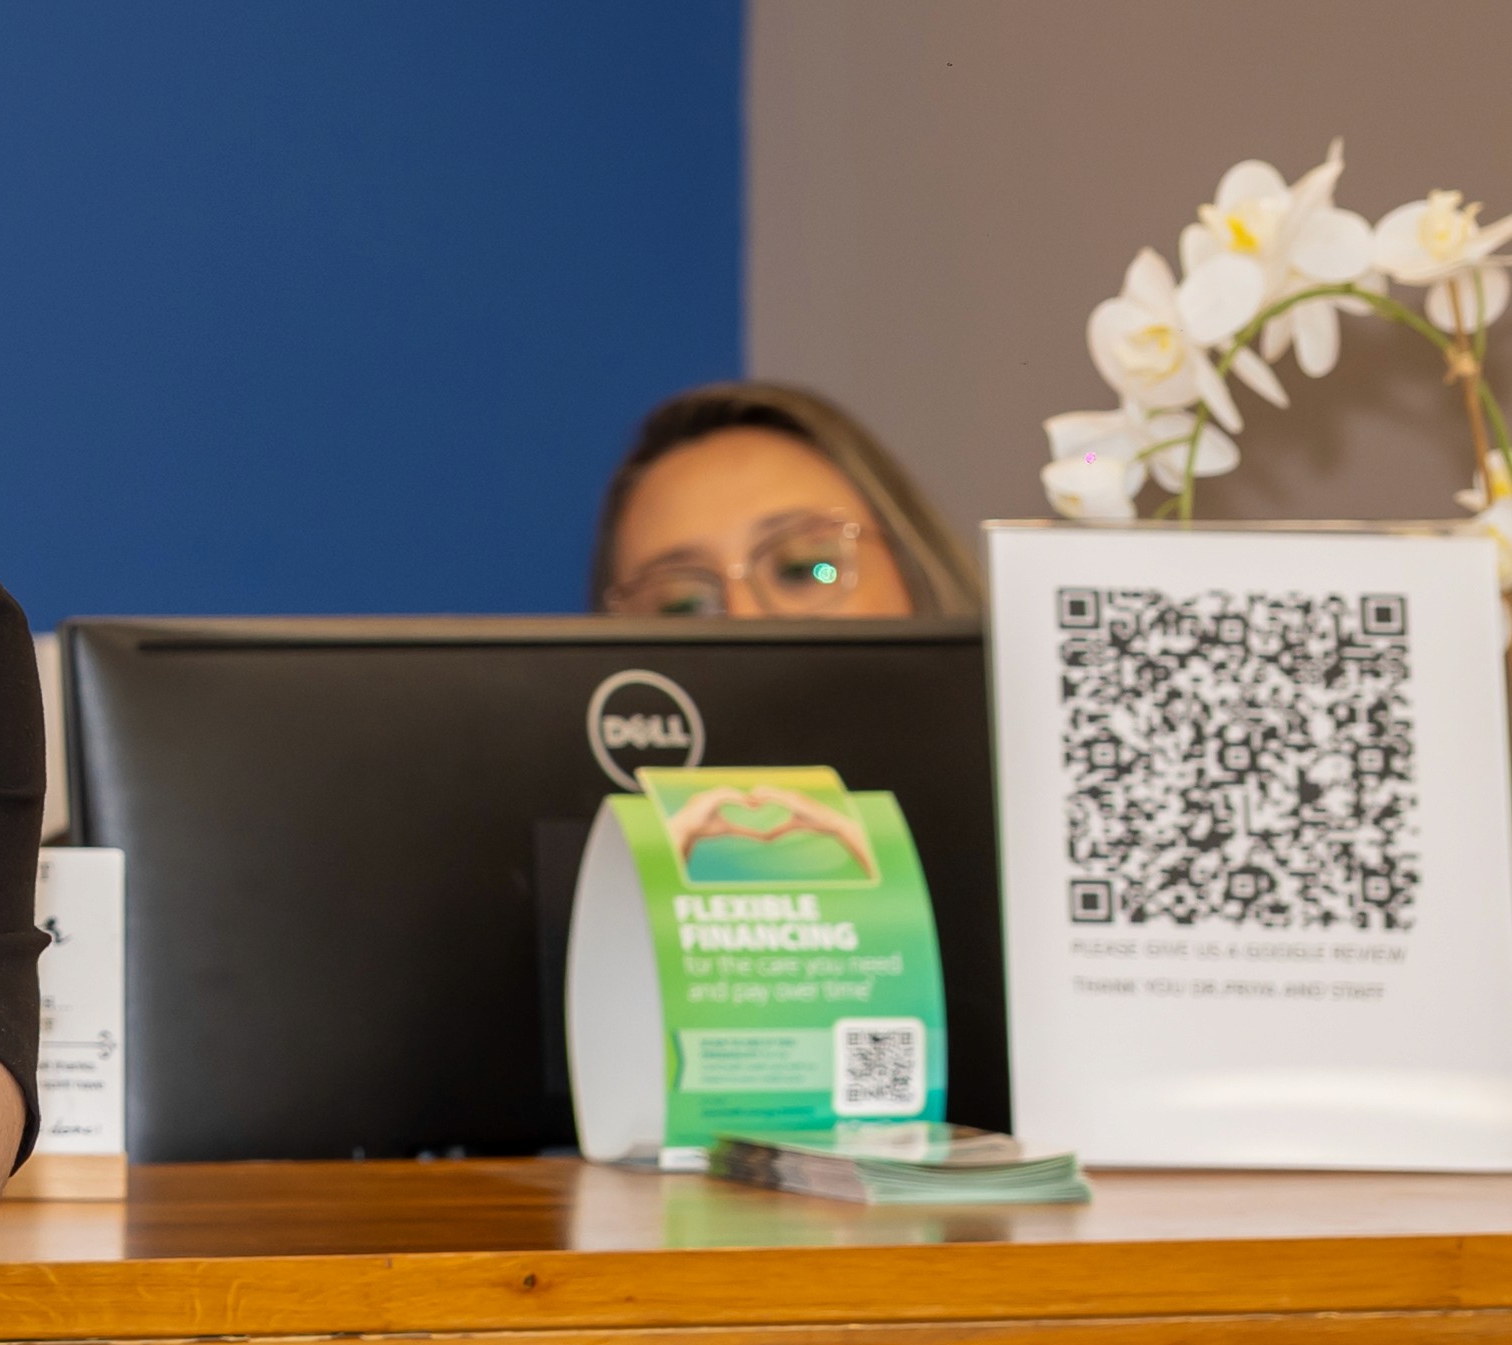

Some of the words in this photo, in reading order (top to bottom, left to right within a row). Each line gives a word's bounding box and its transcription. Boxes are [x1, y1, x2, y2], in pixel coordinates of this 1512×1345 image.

[602, 713, 691, 750] DELL
[673, 894, 820, 921] FLEXIBLE
[679, 921, 859, 951] FINANCING
[684, 954, 712, 975] for
[718, 956, 752, 975] the
[757, 958, 799, 975] care
[805, 958, 843, 978] you
[849, 952, 904, 975] need
[687, 981, 728, 1003] and
[732, 984, 768, 1007] pay
[773, 984, 818, 1002] over
